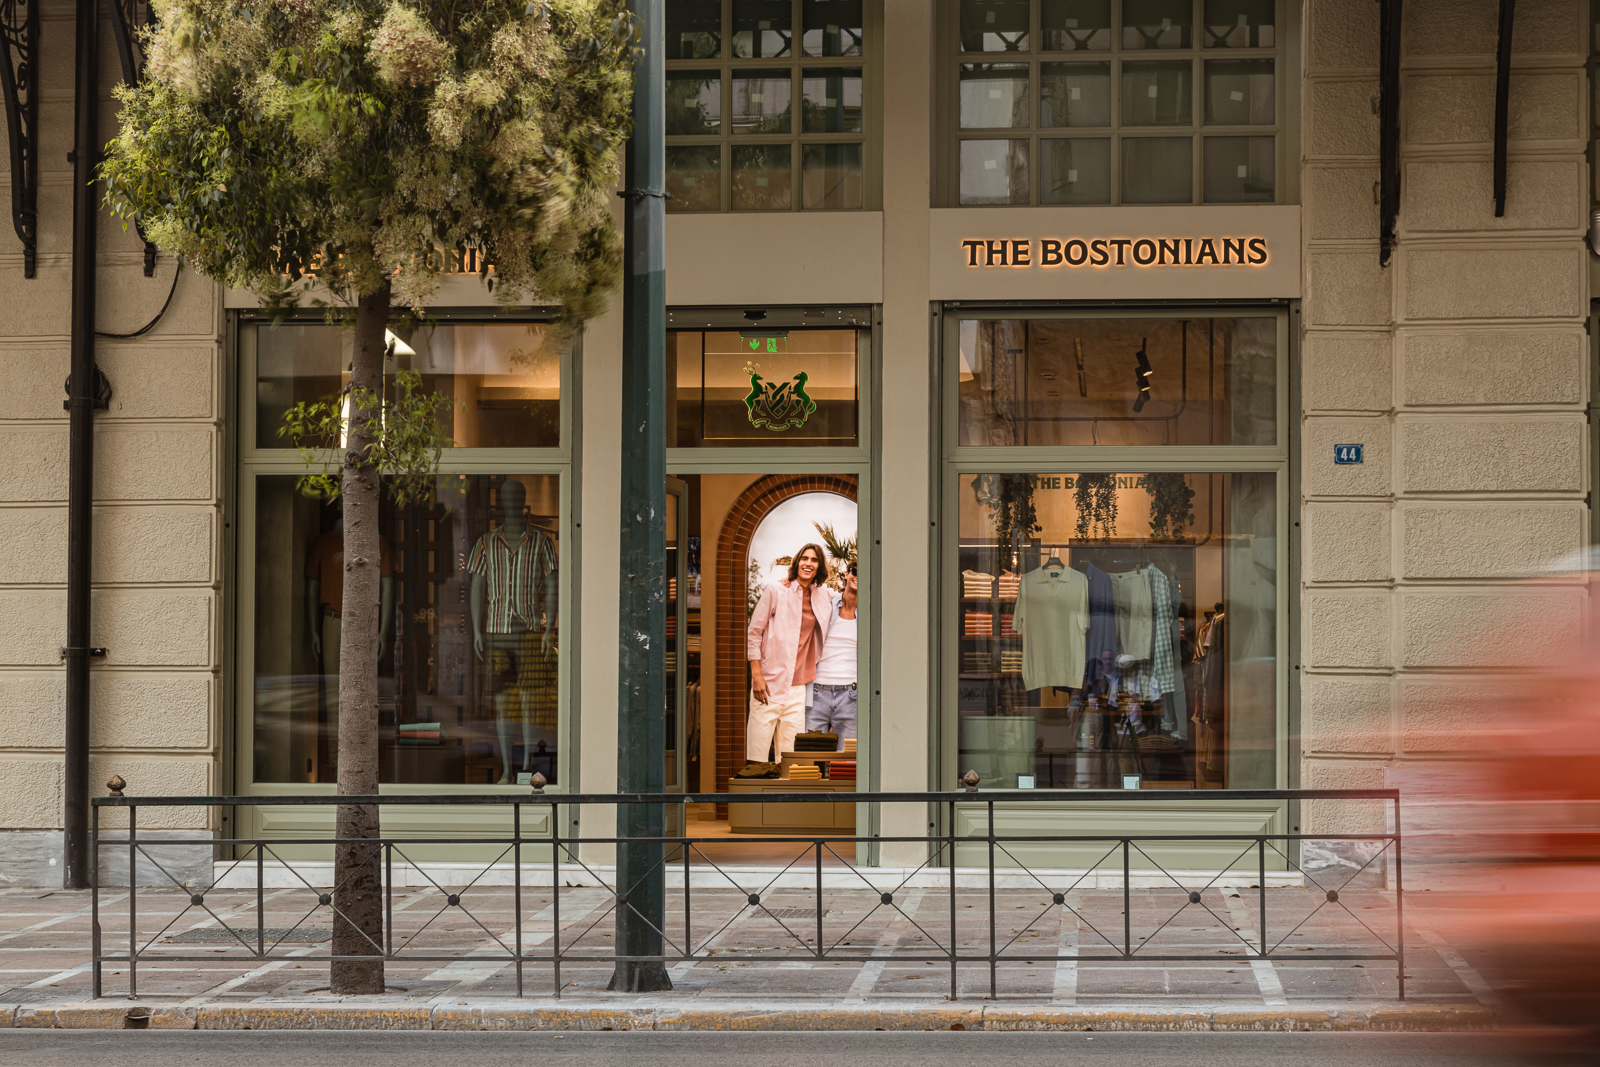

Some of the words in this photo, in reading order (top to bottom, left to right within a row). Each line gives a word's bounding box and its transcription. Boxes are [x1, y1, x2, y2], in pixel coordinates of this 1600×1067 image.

[962, 239, 1031, 266] THE
[1040, 238, 1268, 265] BOSTONIANS
[1340, 447, 1357, 461] 44
